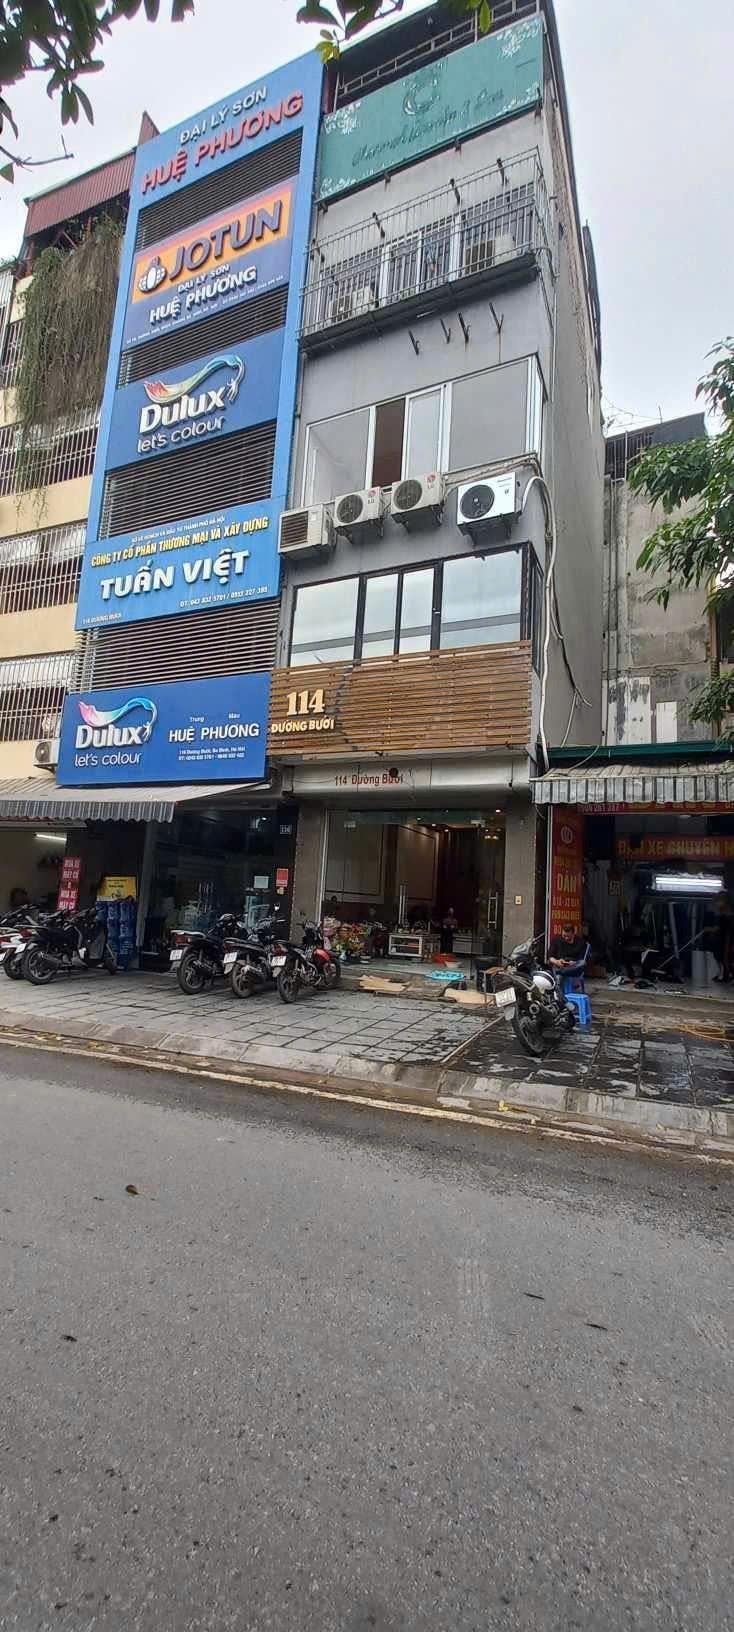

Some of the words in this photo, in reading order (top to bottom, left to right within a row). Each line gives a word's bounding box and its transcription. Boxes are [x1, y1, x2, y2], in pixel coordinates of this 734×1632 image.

[180, 122, 207, 145] ĐẠI
[209, 104, 229, 127] LÝ
[232, 86, 268, 117] SƠN
[141, 149, 188, 195] HUỆ
[194, 91, 304, 168] PHƯƠNG
[169, 200, 282, 281] JOTUN
[150, 296, 182, 325] HUỆ
[186, 266, 257, 309] PHƯƠNG
[139, 386, 226, 434] Dulux
[137, 433, 168, 454] let's
[171, 415, 226, 442] colour
[112, 550, 123, 563] TY
[159, 536, 190, 553] THƯƠNG
[192, 532, 209, 547] MẠI
[211, 525, 221, 541] VÀ
[242, 516, 269, 536] DỰNG
[101, 560, 175, 600] TUẤN
[182, 548, 250, 584] VIỆT
[286, 688, 325, 716] 114
[75, 724, 143, 749] Dulux
[169, 723, 195, 744] HUỆ
[201, 722, 260, 740] PHƯƠNG
[74, 753, 99, 768] let's
[102, 751, 143, 766] colour
[334, 775, 348, 786] 114
[351, 774, 380, 786] Đường
